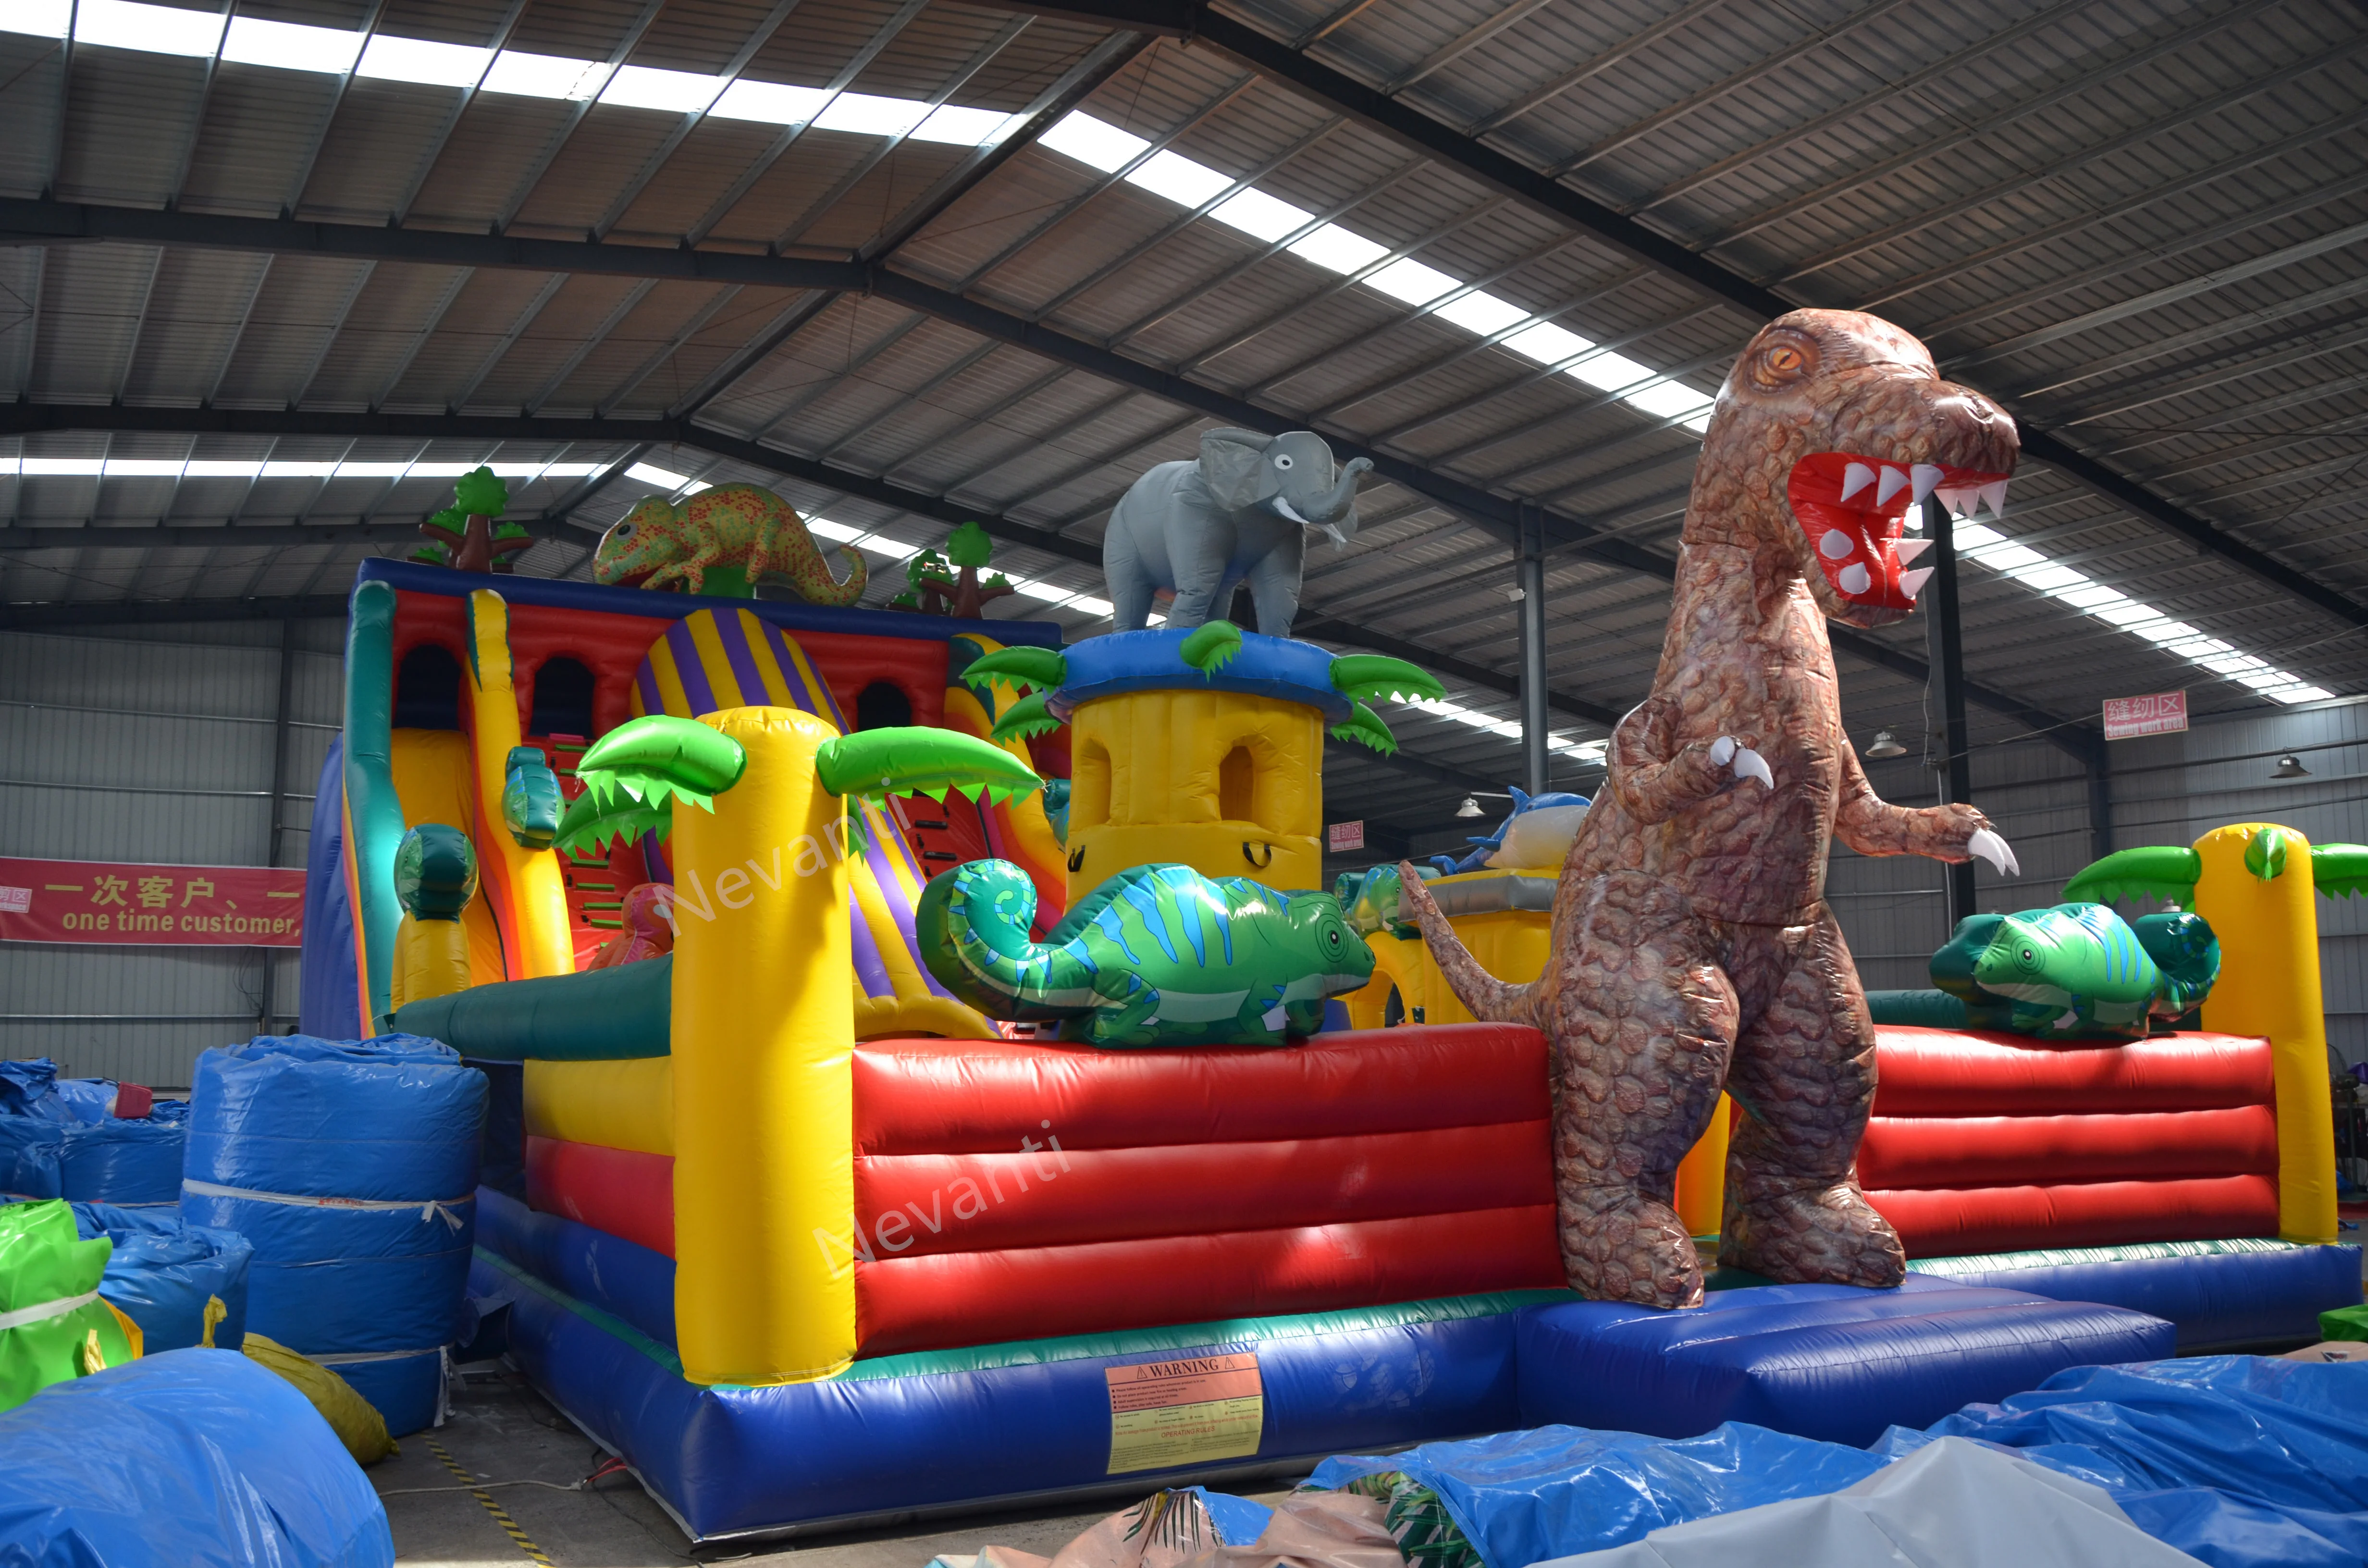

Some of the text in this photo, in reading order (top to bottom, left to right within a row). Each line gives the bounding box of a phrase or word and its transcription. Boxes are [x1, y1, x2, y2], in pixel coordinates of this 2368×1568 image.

[2108, 693, 2182, 722] 缝纫区
[2108, 717, 2183, 737] Sewing work area
[1331, 822, 1361, 840] 缝纫区
[62, 908, 300, 937] one time customer,
[1148, 1359, 1219, 1377] WARNING
[1161, 1428, 1195, 1438] OPERATING
